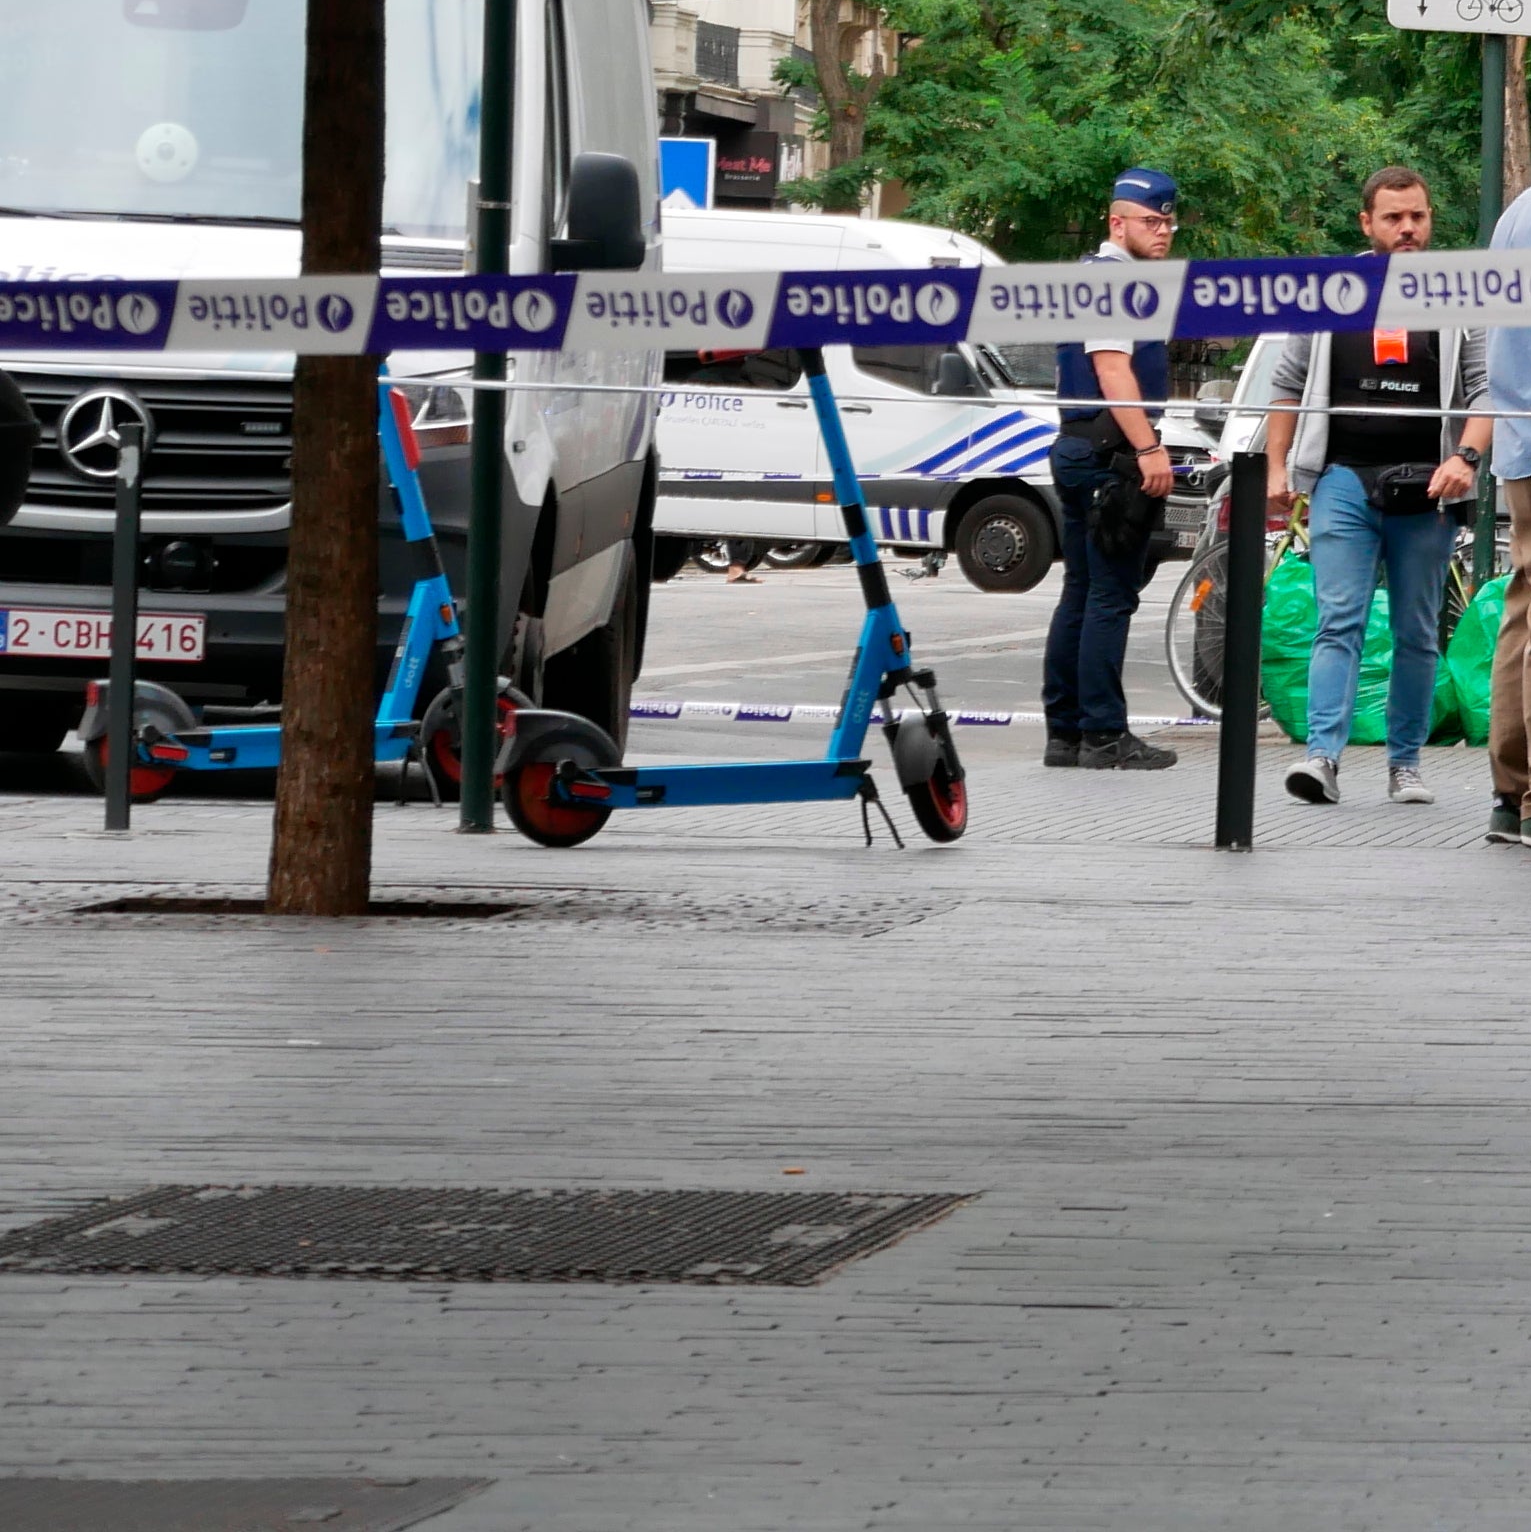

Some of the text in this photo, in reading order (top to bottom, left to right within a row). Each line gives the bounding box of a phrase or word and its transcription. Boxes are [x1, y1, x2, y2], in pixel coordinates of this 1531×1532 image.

[786, 284, 911, 325] Police
[990, 283, 1112, 319] Politie
[1193, 274, 1319, 315] Police
[1400, 269, 1522, 308] Politie
[188, 295, 309, 331] Politie
[386, 290, 508, 330] Police
[586, 290, 707, 327] Politie
[684, 392, 743, 411] Police
[1380, 381, 1420, 392] POLICE
